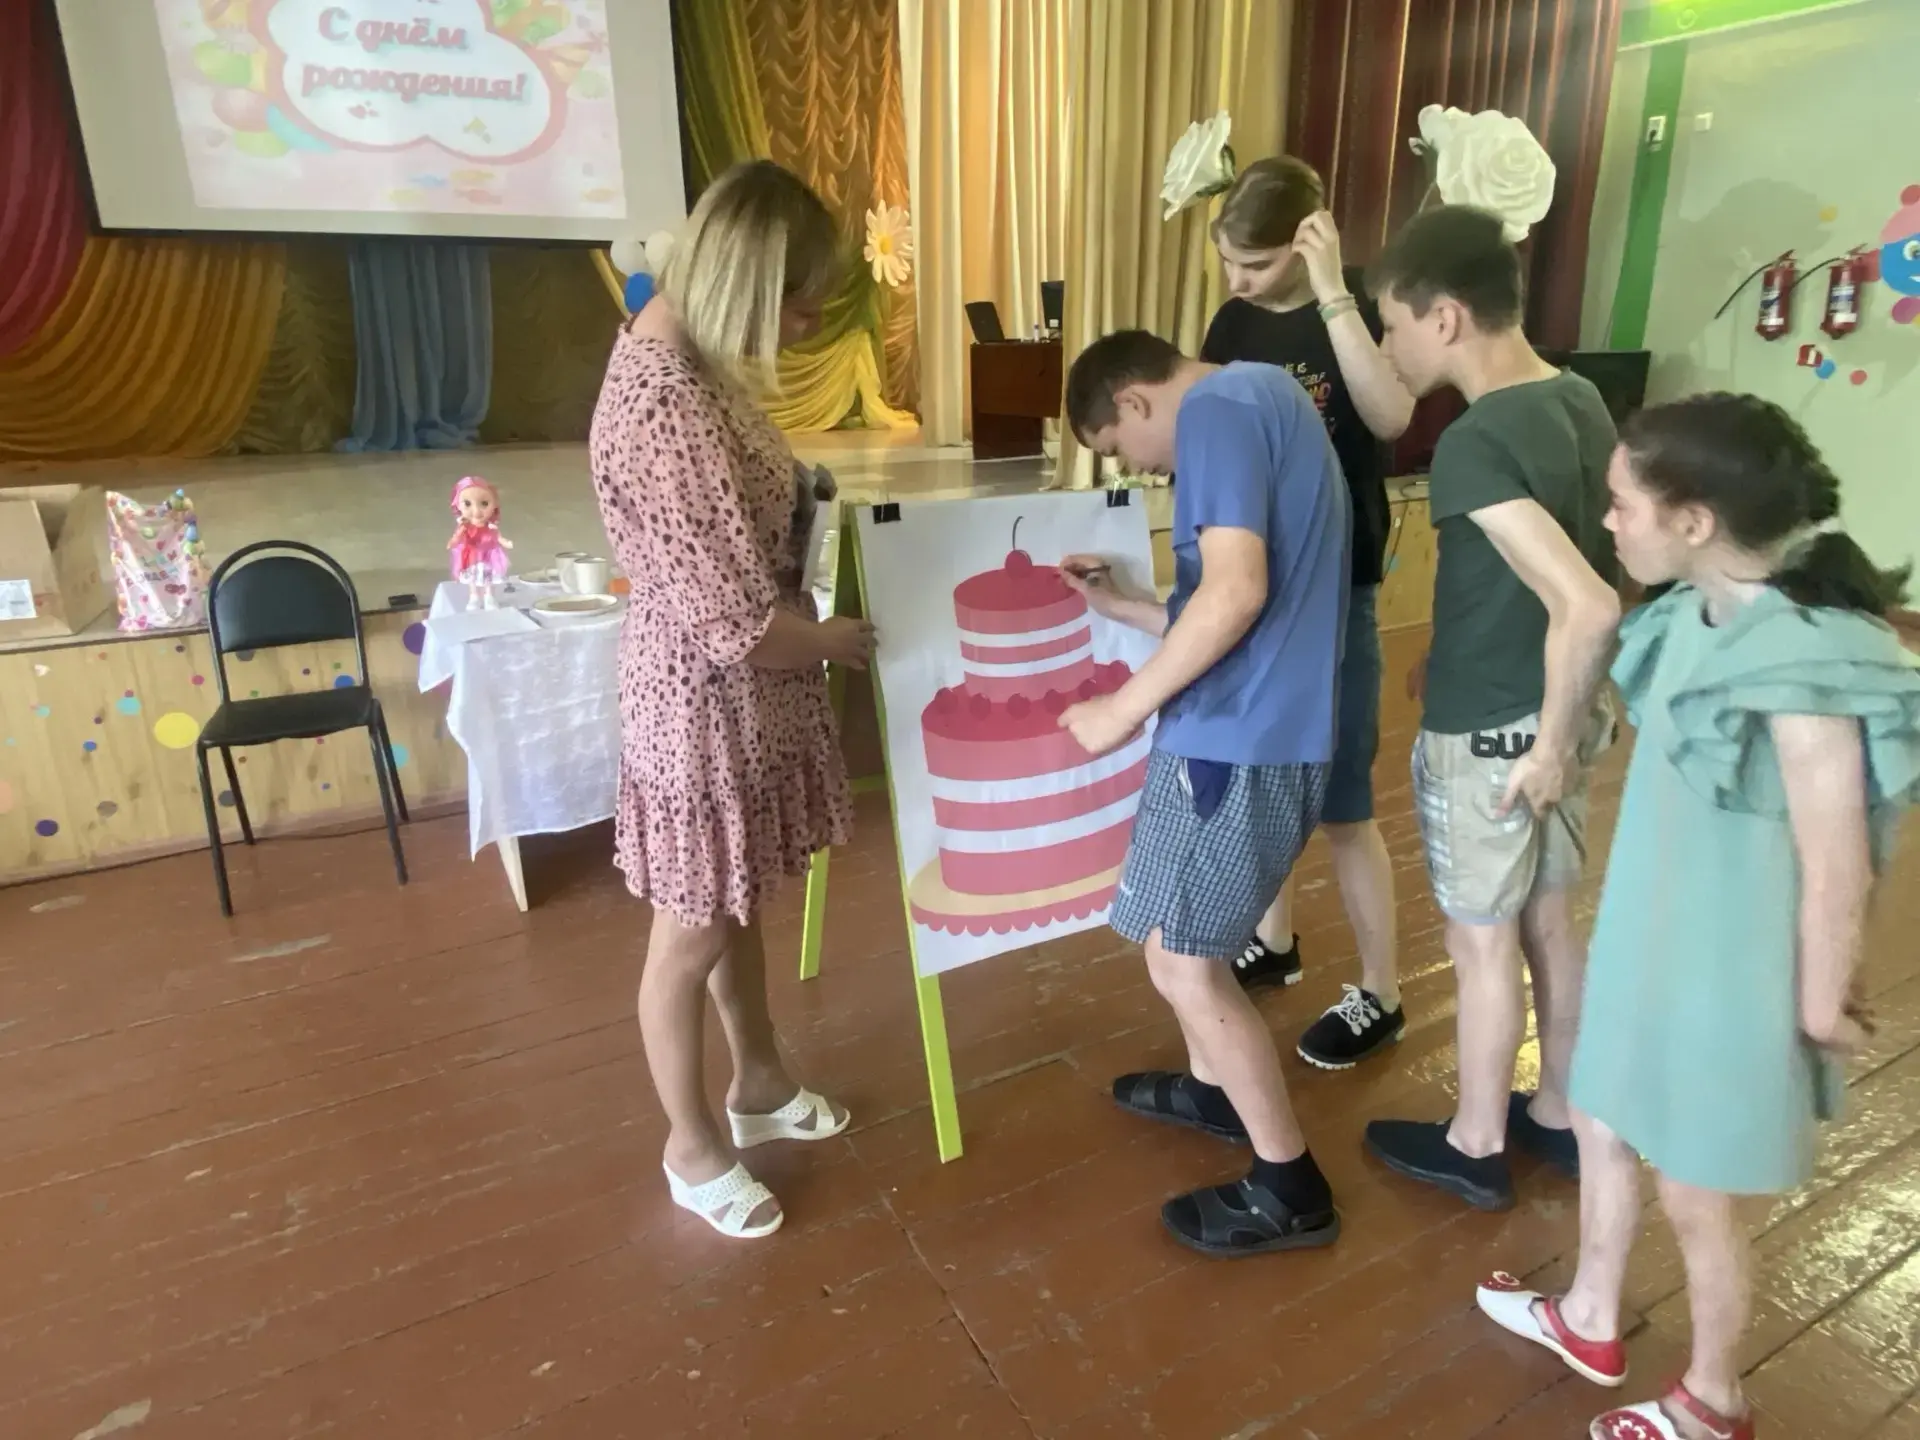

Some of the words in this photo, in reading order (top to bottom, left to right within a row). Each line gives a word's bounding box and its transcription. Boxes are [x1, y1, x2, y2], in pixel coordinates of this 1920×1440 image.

[318, 7, 351, 42] С
[355, 17, 470, 53] днём
[301, 63, 528, 103] рождения!
